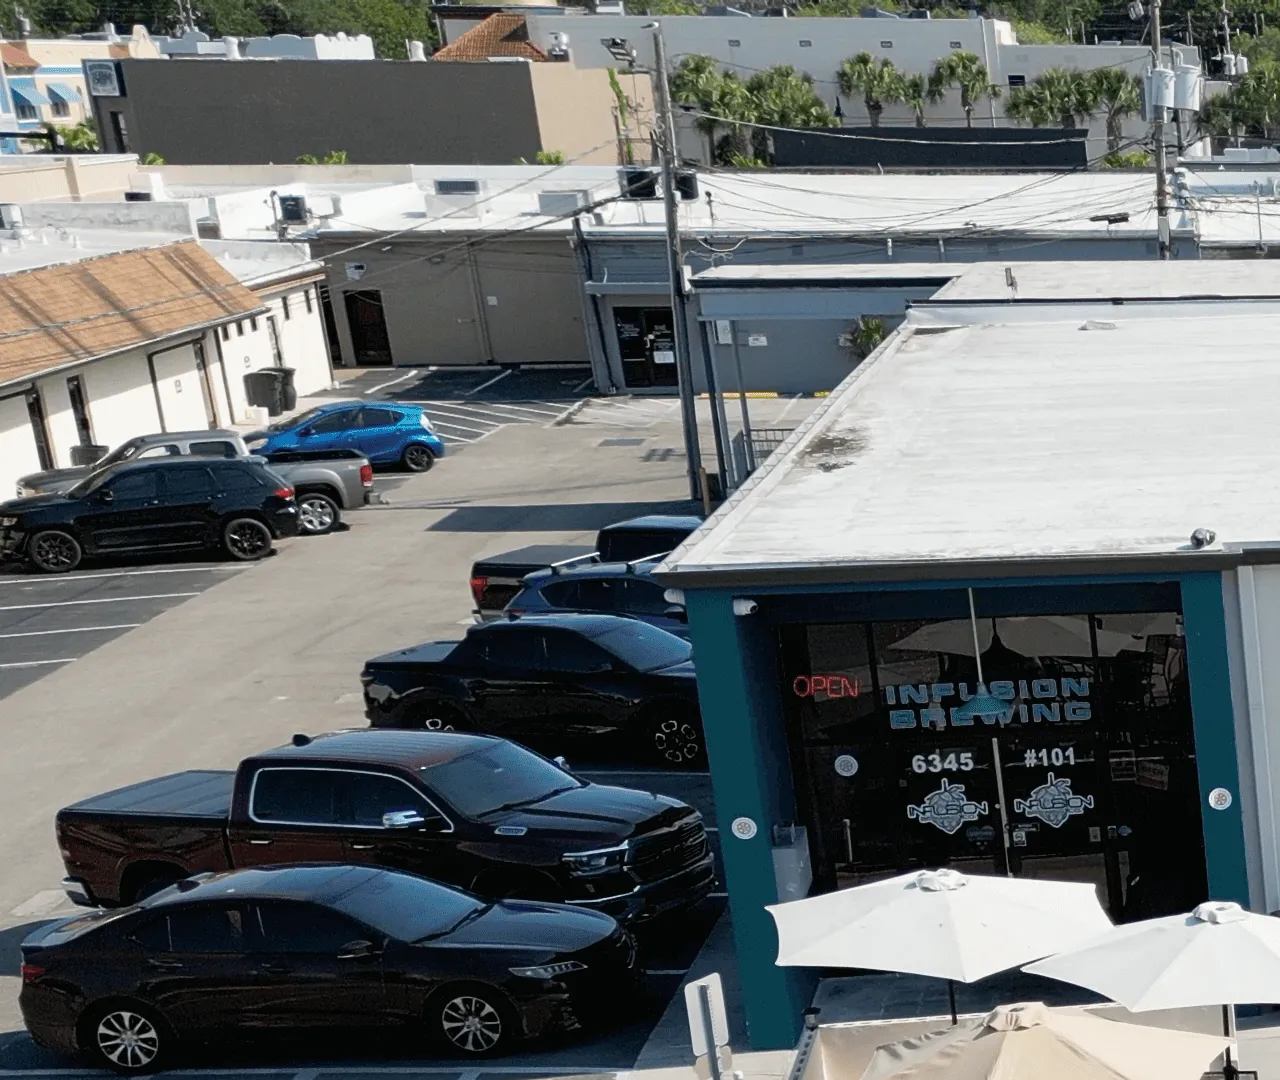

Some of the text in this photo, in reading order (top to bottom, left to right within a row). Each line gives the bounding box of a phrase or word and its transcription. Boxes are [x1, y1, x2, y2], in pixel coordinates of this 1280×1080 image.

[793, 675, 858, 698] OPEN
[886, 677, 1089, 705] INFUSION
[889, 701, 1092, 729] BREWING
[912, 753, 974, 774] 6345
[1024, 748, 1076, 767] #101
